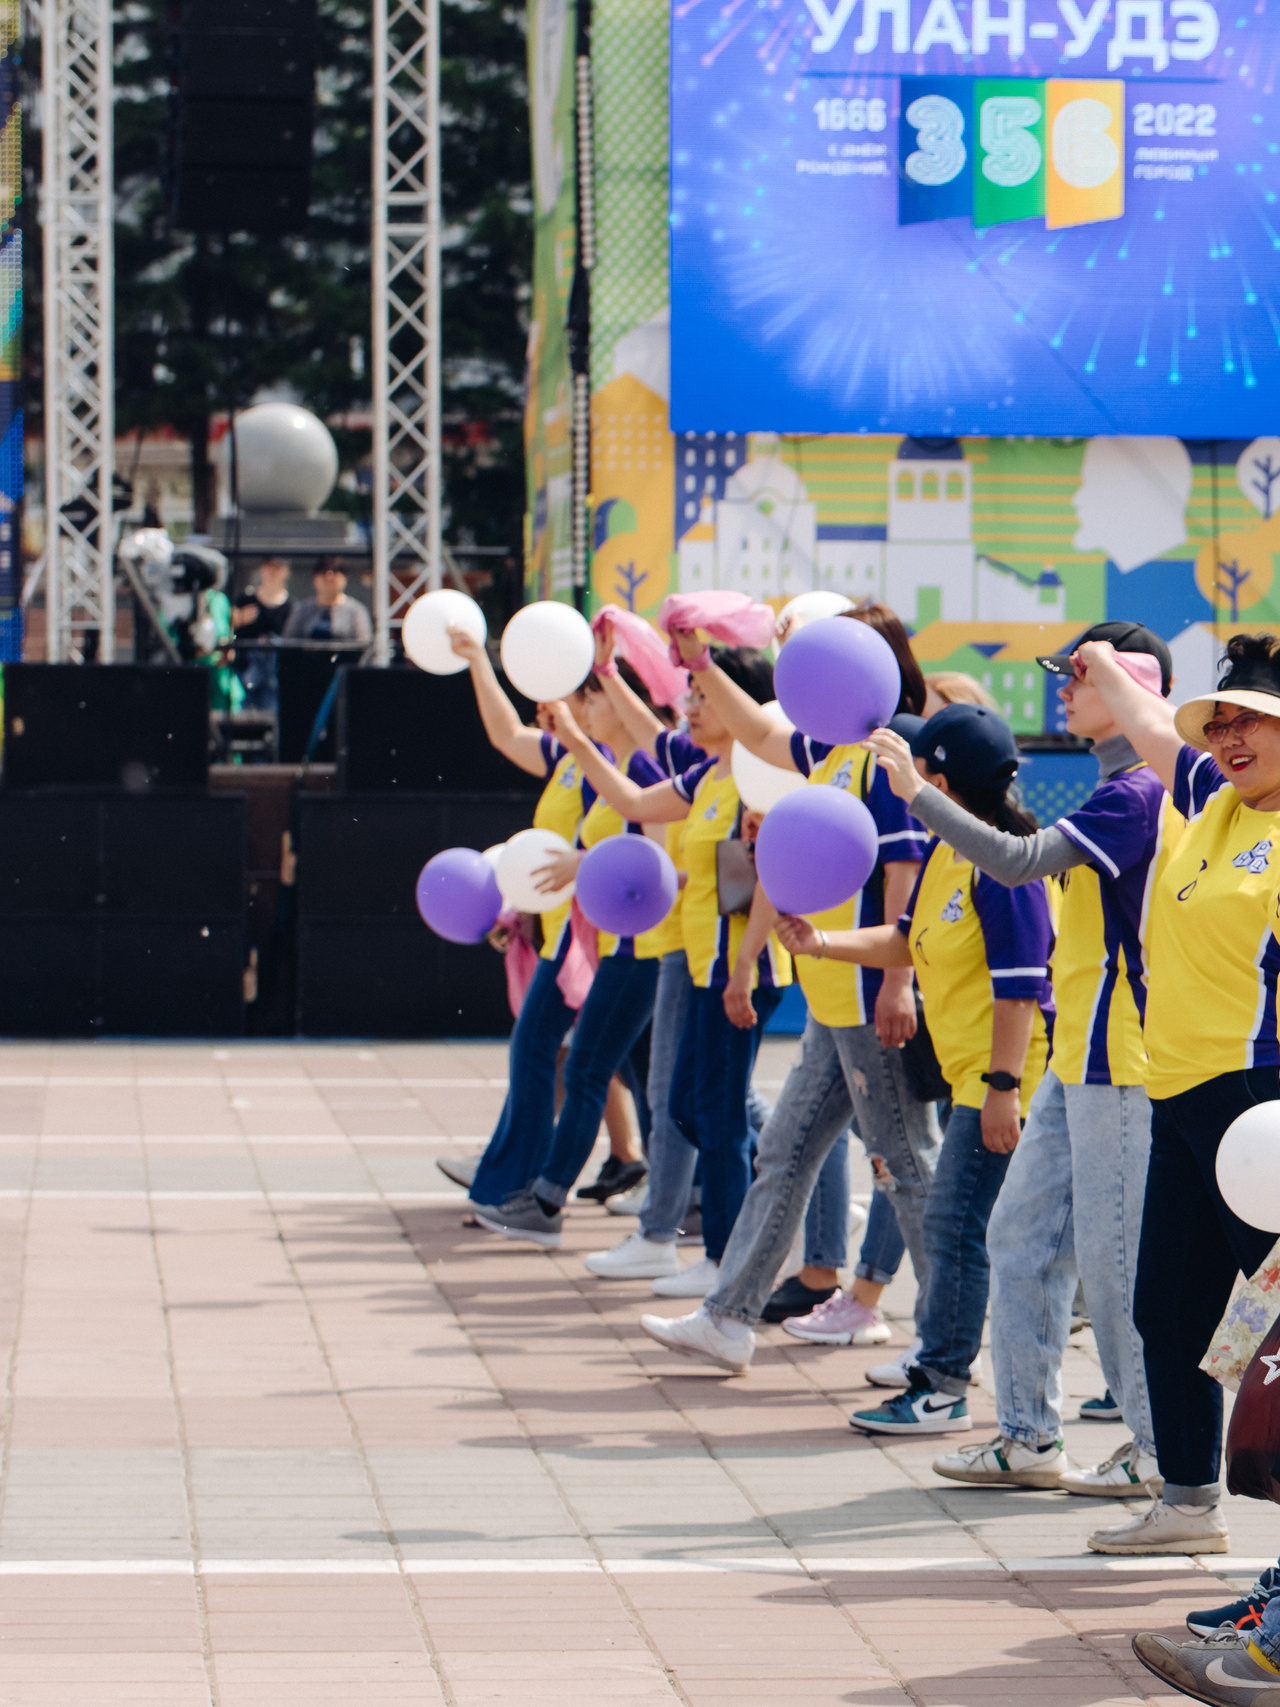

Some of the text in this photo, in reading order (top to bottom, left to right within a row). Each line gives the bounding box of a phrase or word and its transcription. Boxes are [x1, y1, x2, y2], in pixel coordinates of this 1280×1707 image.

[809, 0, 1220, 71] УЛАН-УДЭ
[813, 98, 888, 132] 1666
[1133, 103, 1217, 137] 2022
[905, 95, 1120, 189] 356
